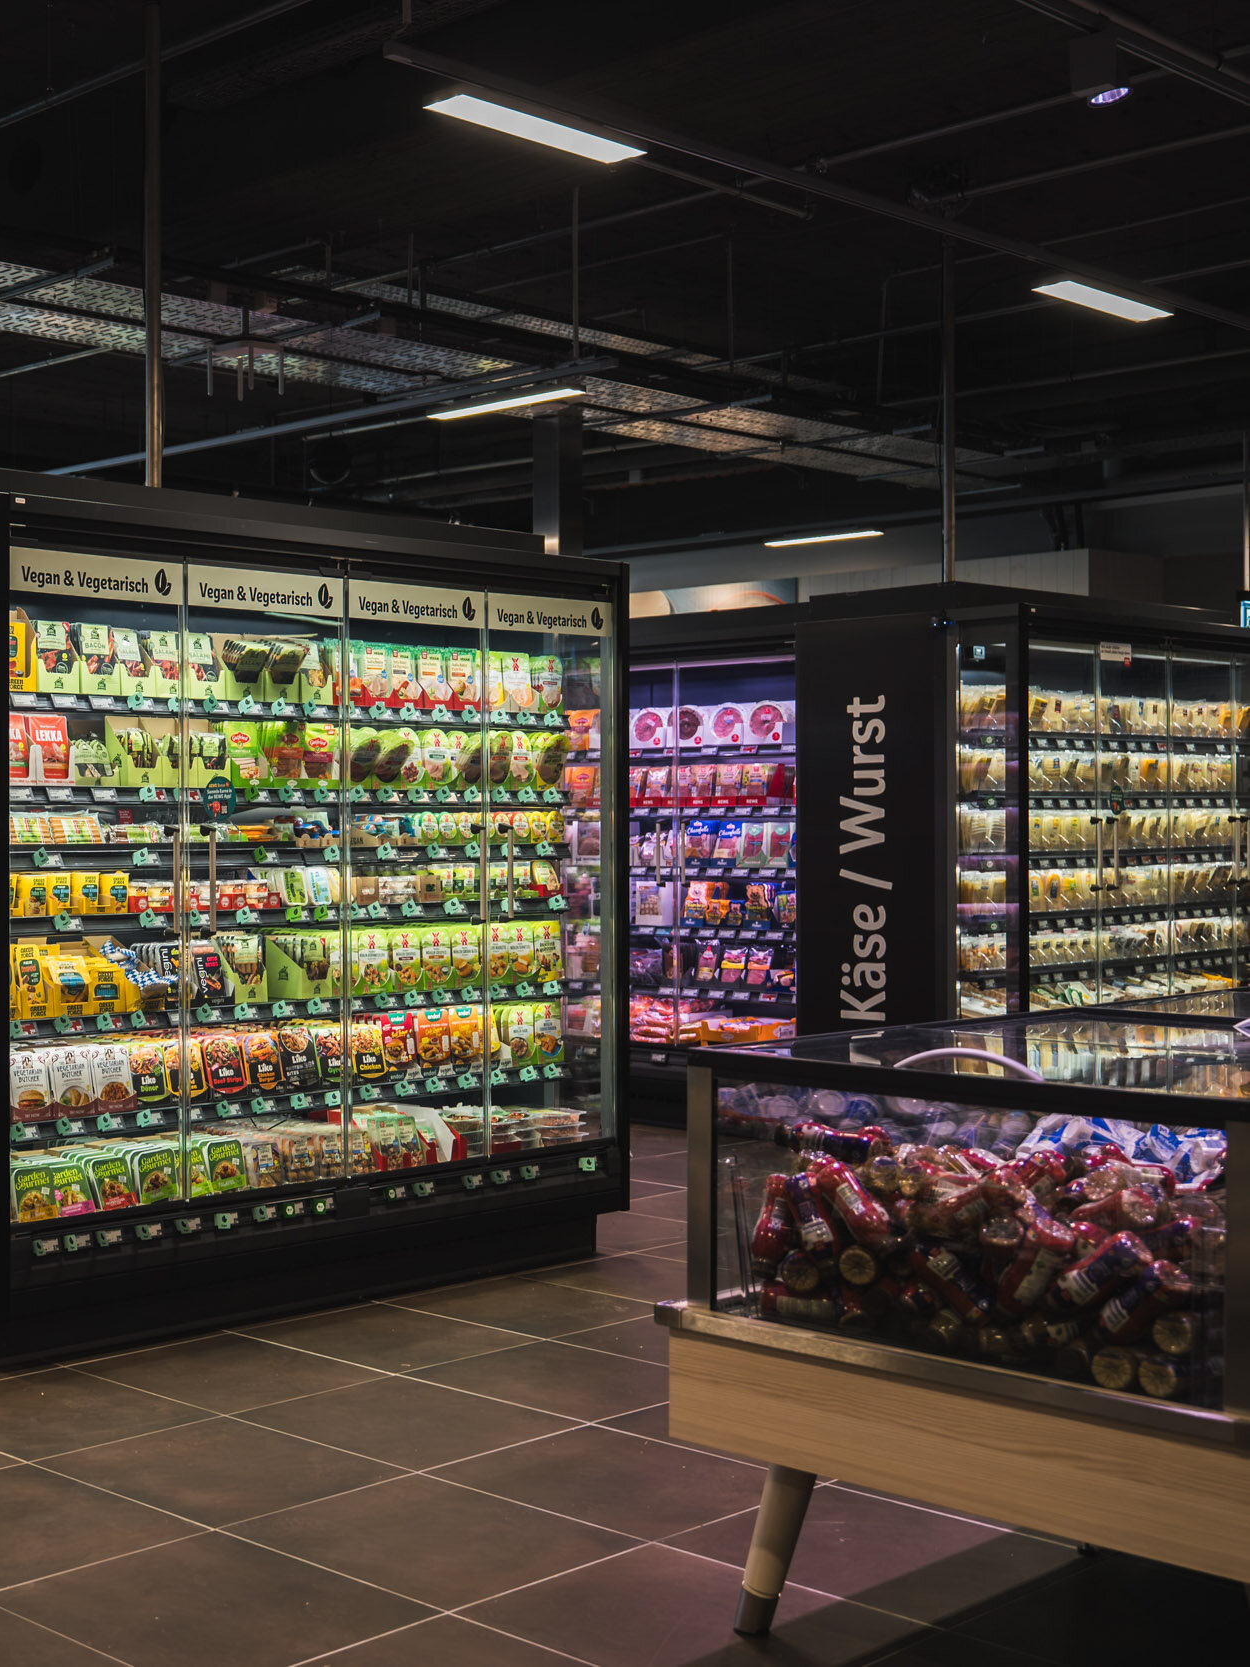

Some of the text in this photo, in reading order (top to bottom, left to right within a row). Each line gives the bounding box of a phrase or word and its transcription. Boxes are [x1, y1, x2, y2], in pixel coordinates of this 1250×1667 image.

[21, 566, 148, 593] Vegan & Vegetarisch
[199, 582, 312, 607] Vegan & Vegetarisch
[358, 596, 458, 619] Vegan & Vegetarisch
[497, 608, 587, 629] Vegan & Vegetarisch
[36, 730, 63, 742] LEKKA
[839, 694, 893, 1022] Käse / Wurst
[161, 948, 173, 977] egini
[197, 958, 208, 992] vegini
[57, 1064, 85, 1072] VEGETARIAN
[97, 1060, 125, 1069] VEGETARIAN
[13, 1069, 42, 1077] VEGETARIAN
[61, 1070, 82, 1078] BUTCHER
[211, 1143, 236, 1154] Garden
[141, 1152, 168, 1164] Garden
[209, 1149, 239, 1161] Gourmet
[95, 1161, 121, 1172] Garden
[139, 1158, 172, 1172] Gourmet
[17, 1171, 46, 1183] Garden
[94, 1167, 126, 1179] Gourmet
[16, 1177, 50, 1190] Gourmet
